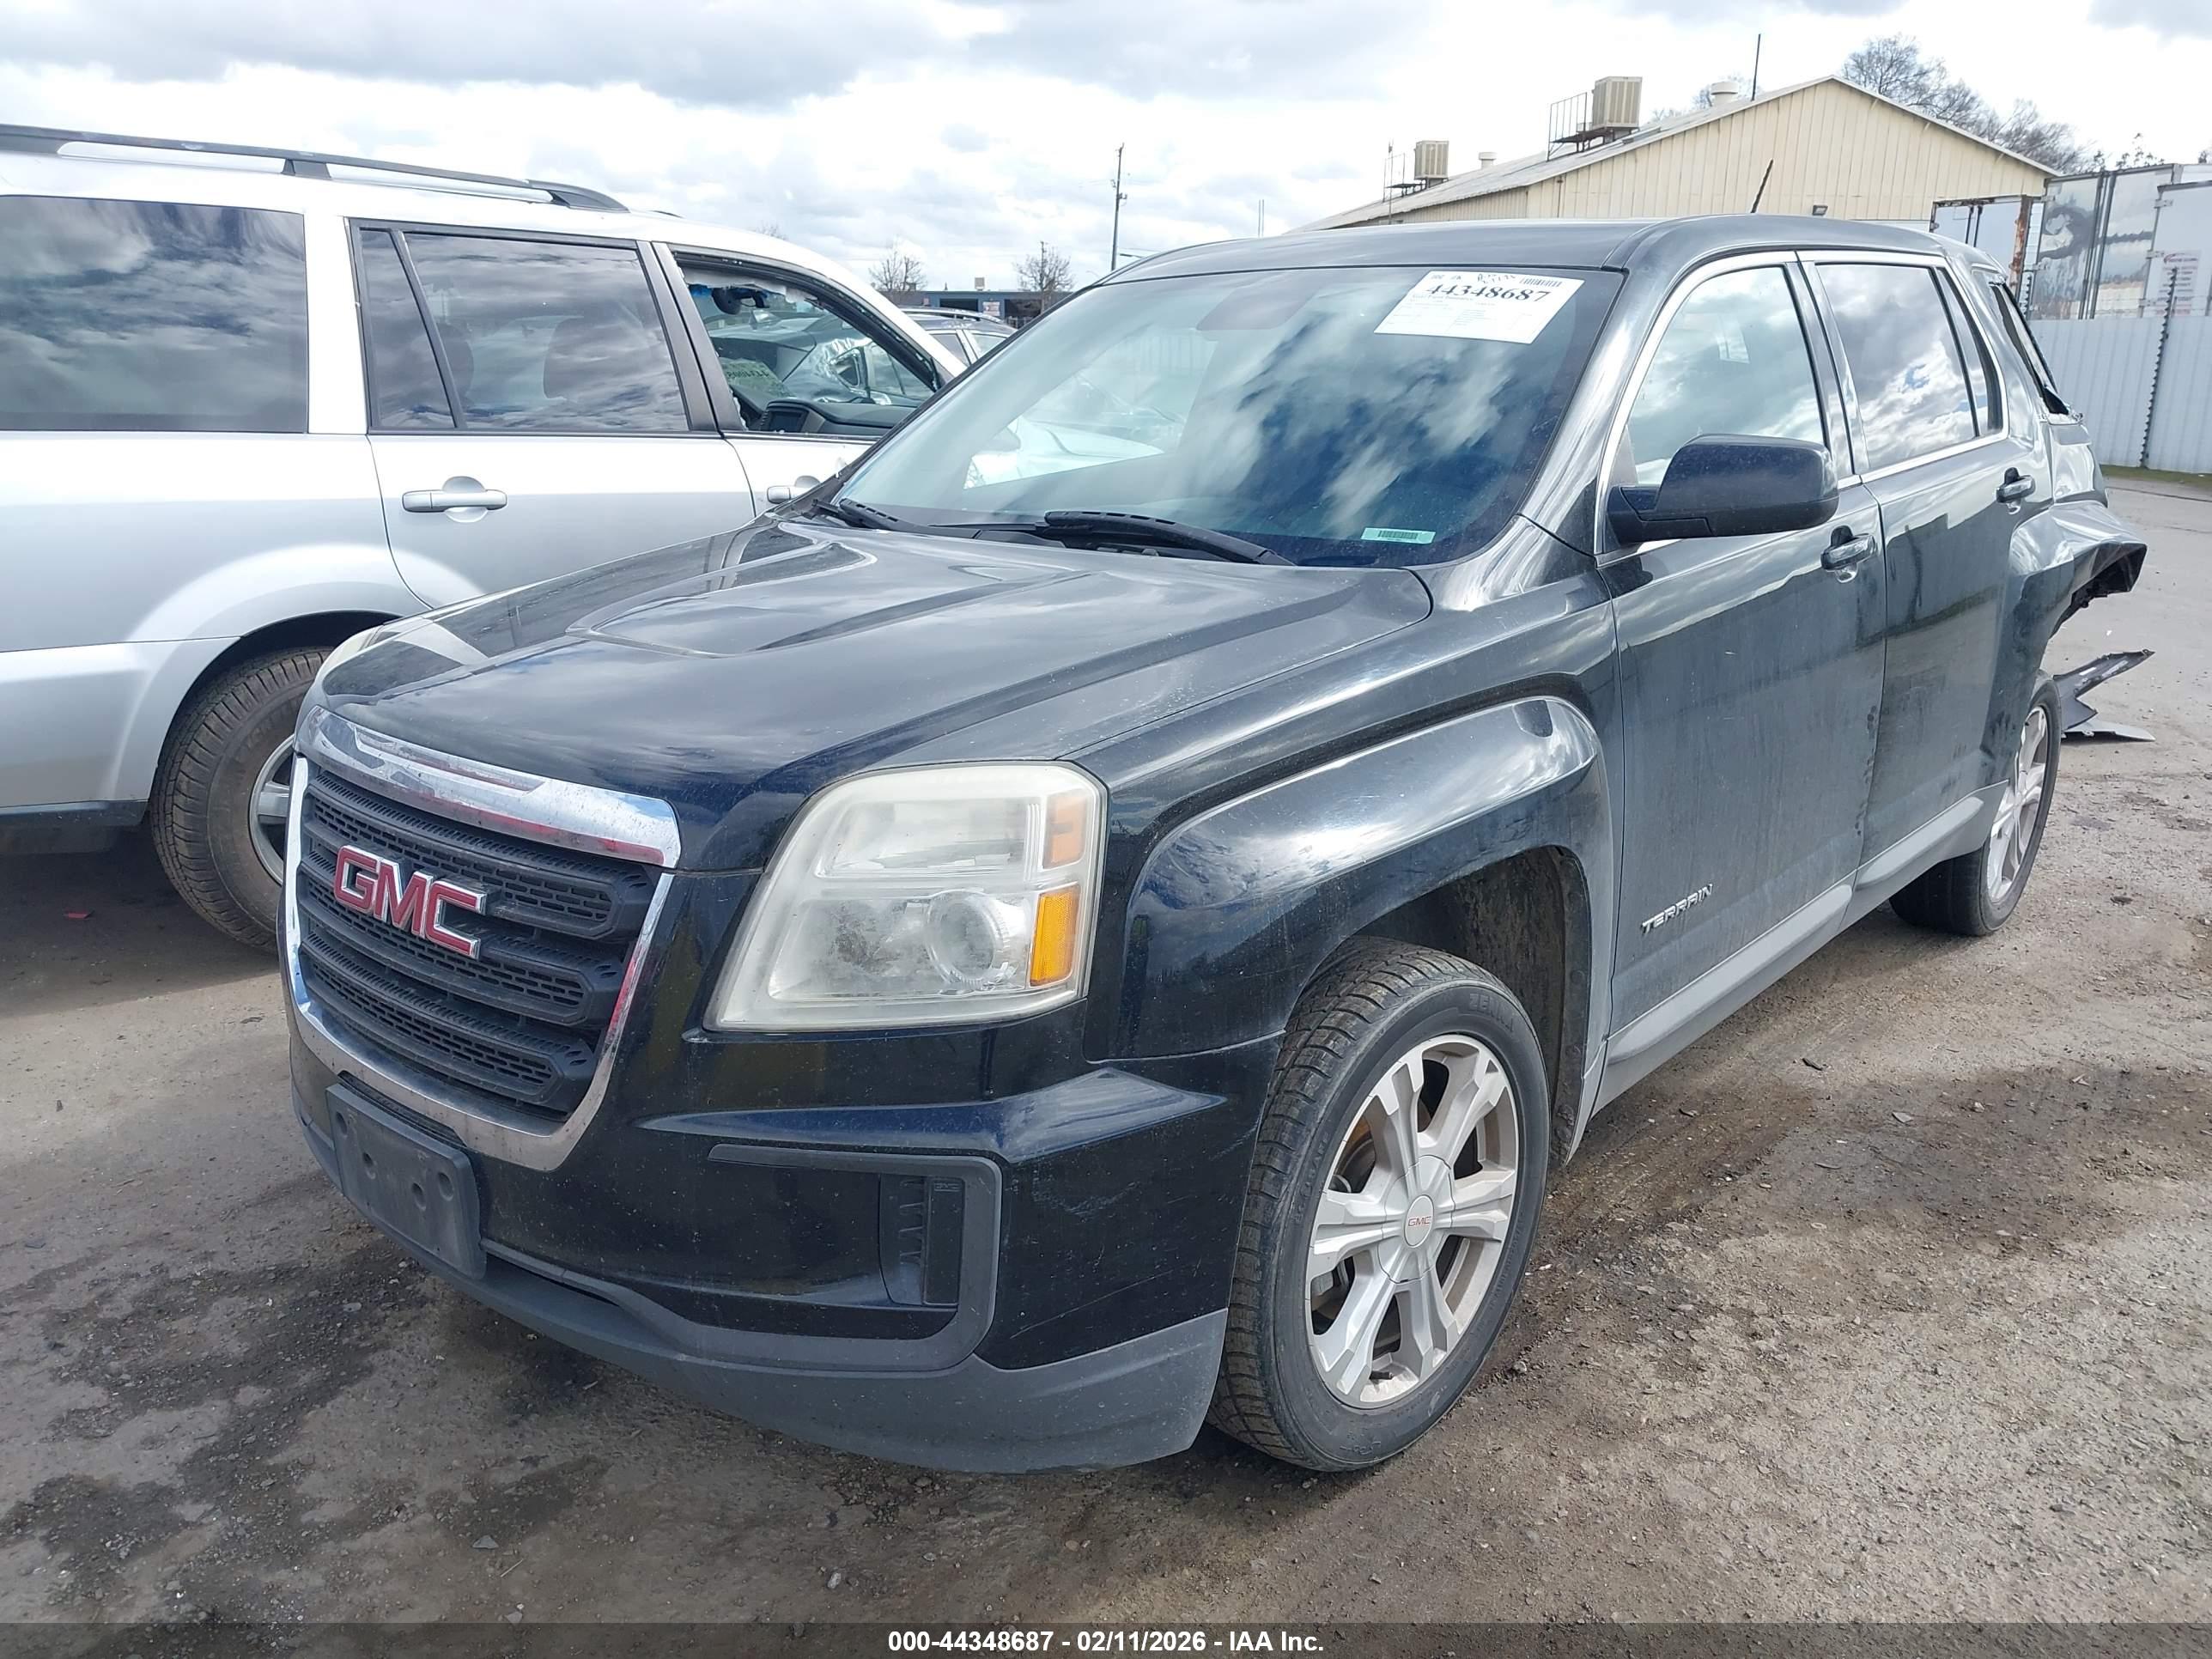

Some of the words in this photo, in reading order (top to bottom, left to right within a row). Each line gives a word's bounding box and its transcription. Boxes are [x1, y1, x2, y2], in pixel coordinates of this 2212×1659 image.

[1425, 283, 1552, 302] 44348687
[333, 844, 487, 960] GMC
[1641, 883, 1713, 934] TERRAIN
[1407, 1215, 1432, 1227] GMC
